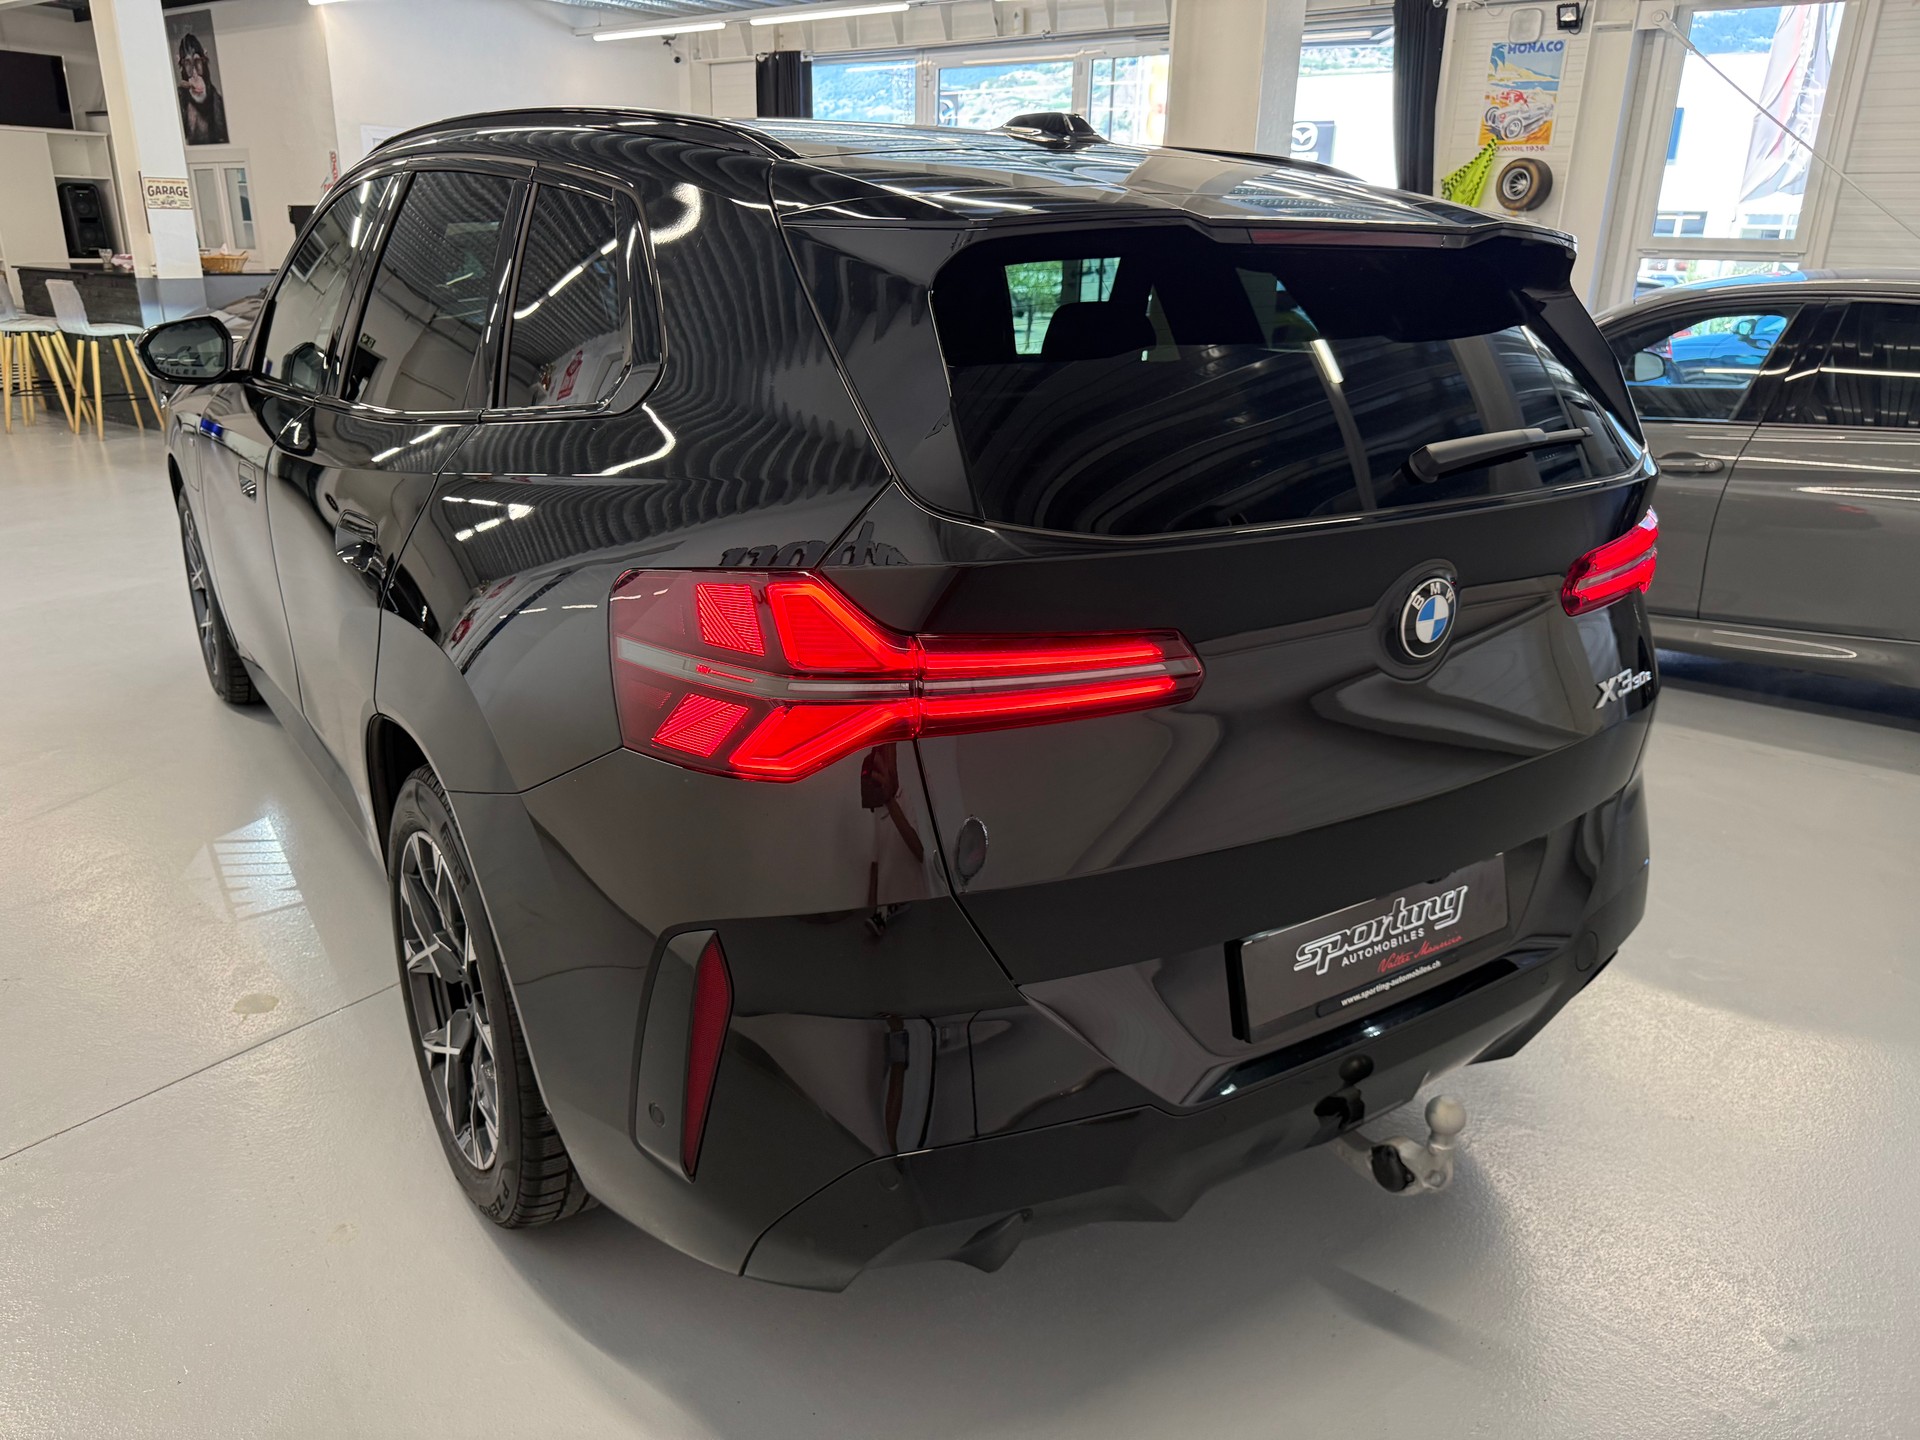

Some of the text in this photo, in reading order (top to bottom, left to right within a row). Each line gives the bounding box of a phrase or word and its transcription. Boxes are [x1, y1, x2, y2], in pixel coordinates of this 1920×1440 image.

[1507, 41, 1564, 54] MONACO
[147, 185, 189, 198] GARAGE
[1411, 581, 1455, 611] BMW
[1595, 668, 1632, 710] X3
[1341, 927, 1425, 967] AUTOMOBILES
[1341, 960, 1442, 1007] www.sporting-automobiles.ch
